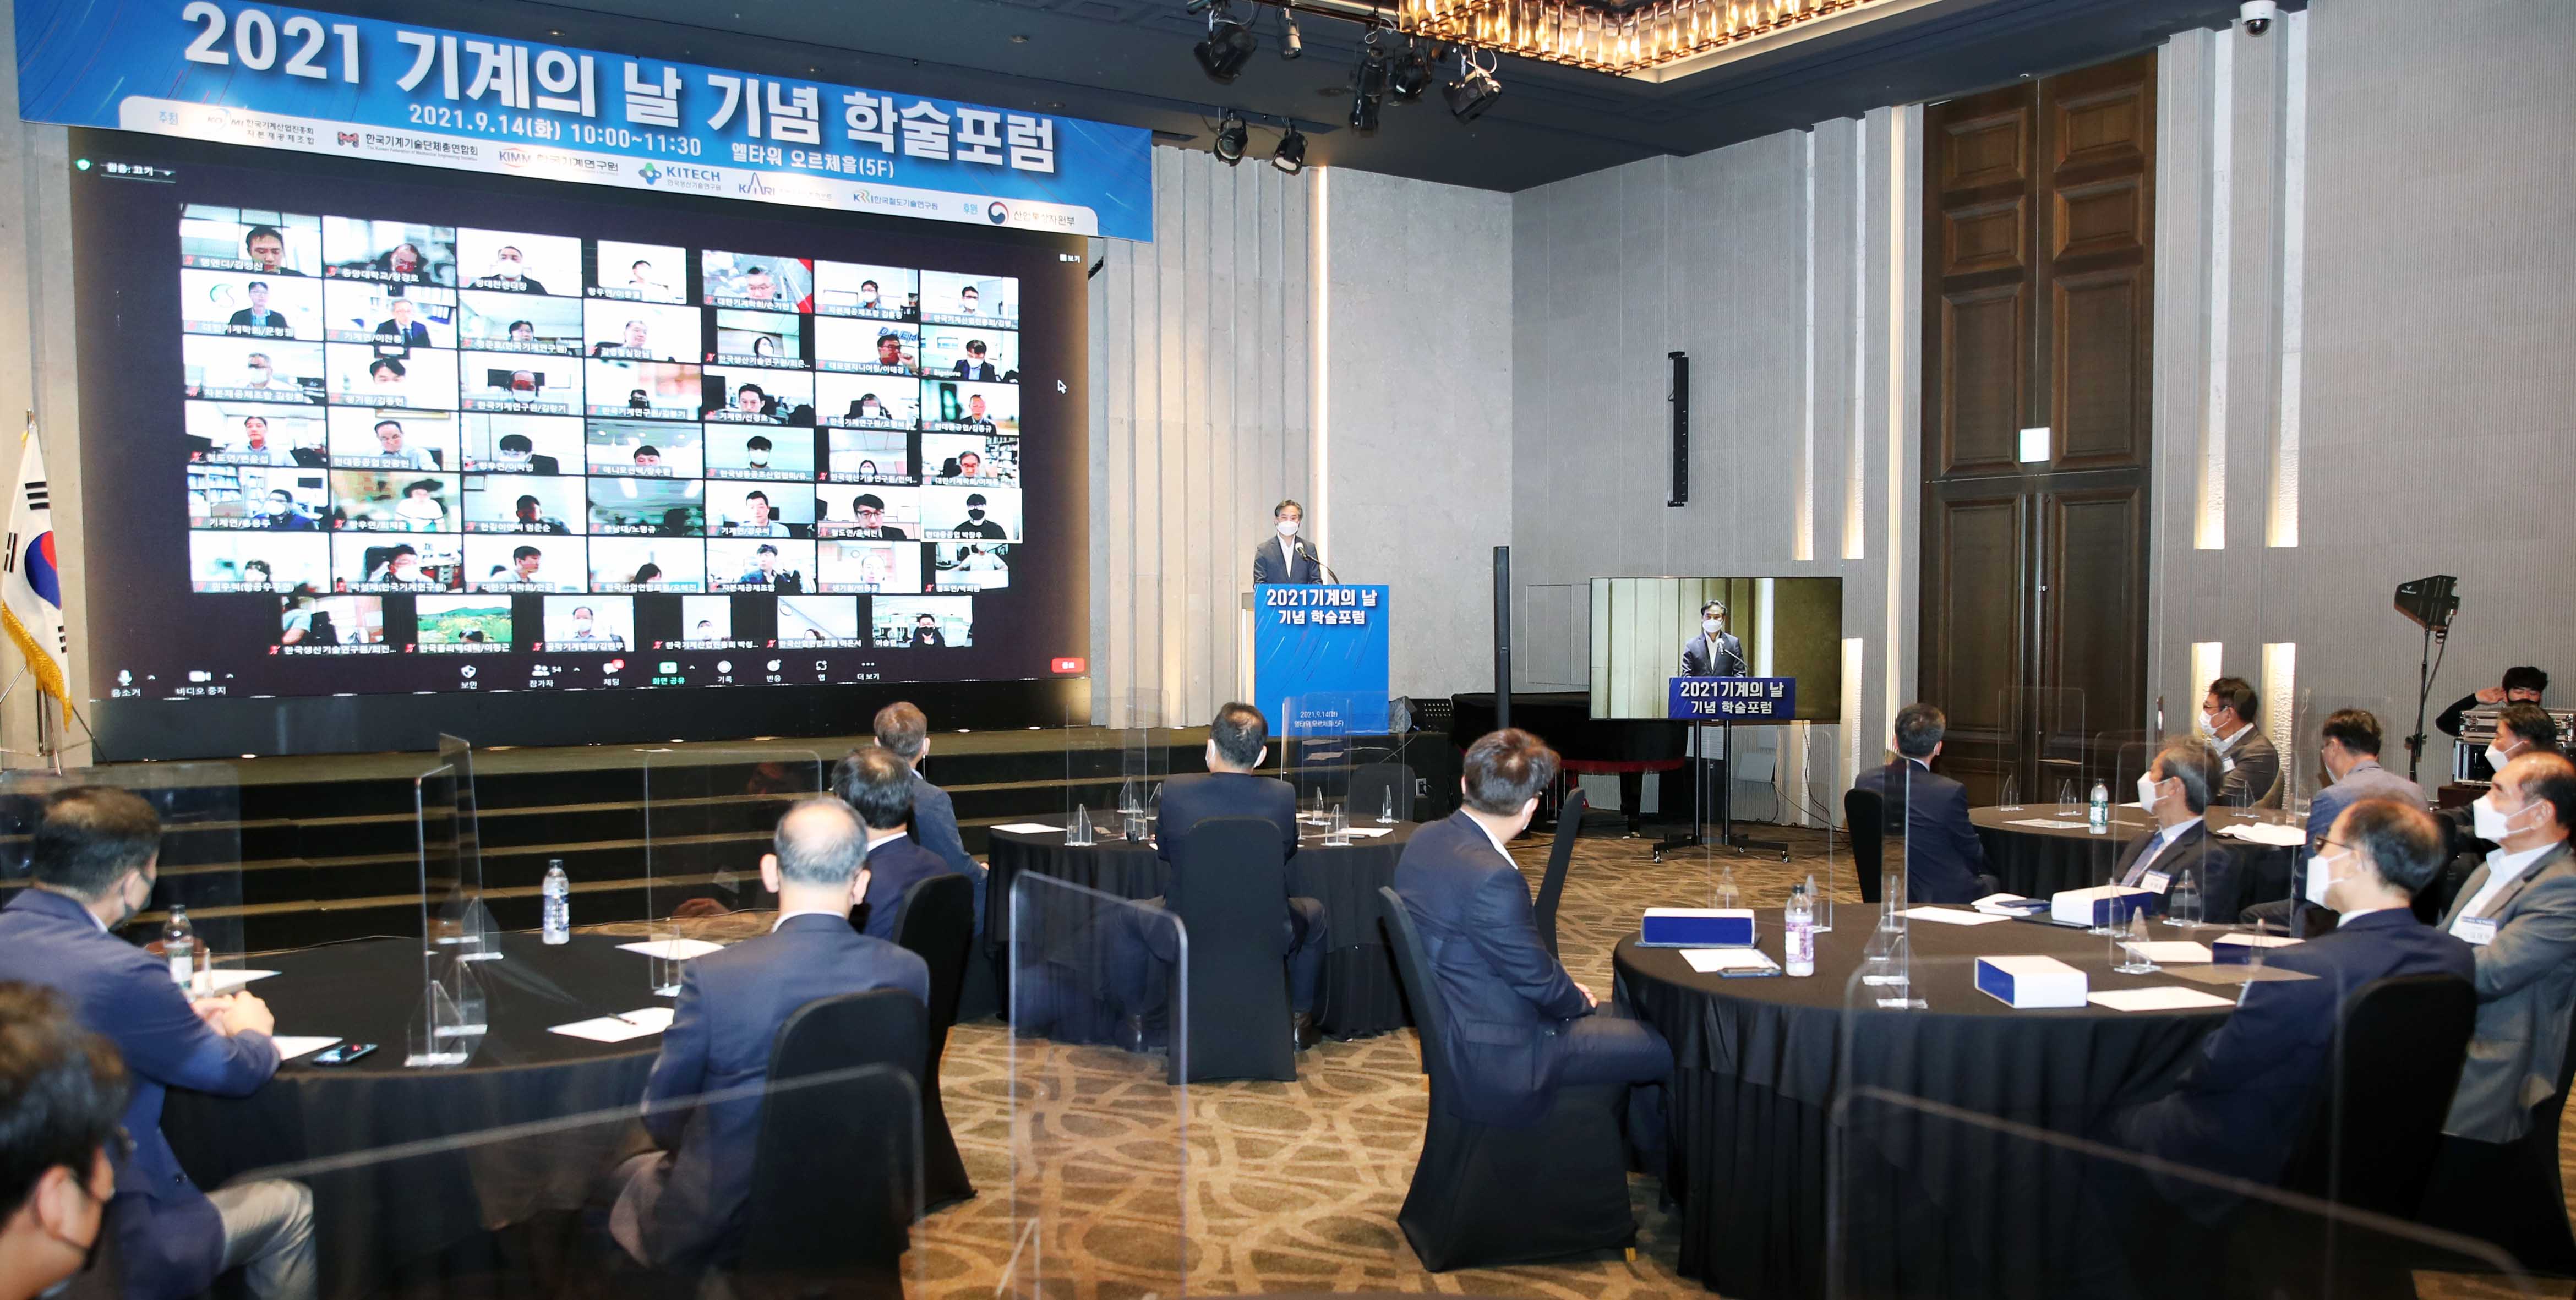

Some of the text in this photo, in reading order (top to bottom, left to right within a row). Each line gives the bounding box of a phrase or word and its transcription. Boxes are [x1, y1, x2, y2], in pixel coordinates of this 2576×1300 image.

[182, 2, 1054, 173] 2021 기계의 날 기념 학술포럼
[245, 119, 314, 135] 한국기계산업진흥회
[365, 133, 478, 156] 한국기계기술단체총연합회
[410, 104, 894, 178] 2021.9.14(화) 10:00~11:30 엘타워 오르체홀(5F)
[499, 151, 532, 164] KIMM
[667, 166, 721, 182] KITECH
[667, 179, 722, 192] 한국생산기술연구원
[874, 195, 938, 211] 한국철도기술연구원
[963, 203, 978, 215] 후원
[1266, 588, 1378, 607] 2021기계의 날
[1278, 609, 1366, 625] 기념 학술포럼
[460, 681, 478, 689] 보안
[529, 679, 554, 688] 참가자
[603, 678, 620, 686] 채팅
[652, 676, 685, 685] 화면 공유
[111, 688, 141, 698] 음소거
[174, 687, 205, 696] 비디오
[1680, 682, 1784, 697] 2021기계의 날
[1691, 701, 1772, 713] 기념 학술포럼
